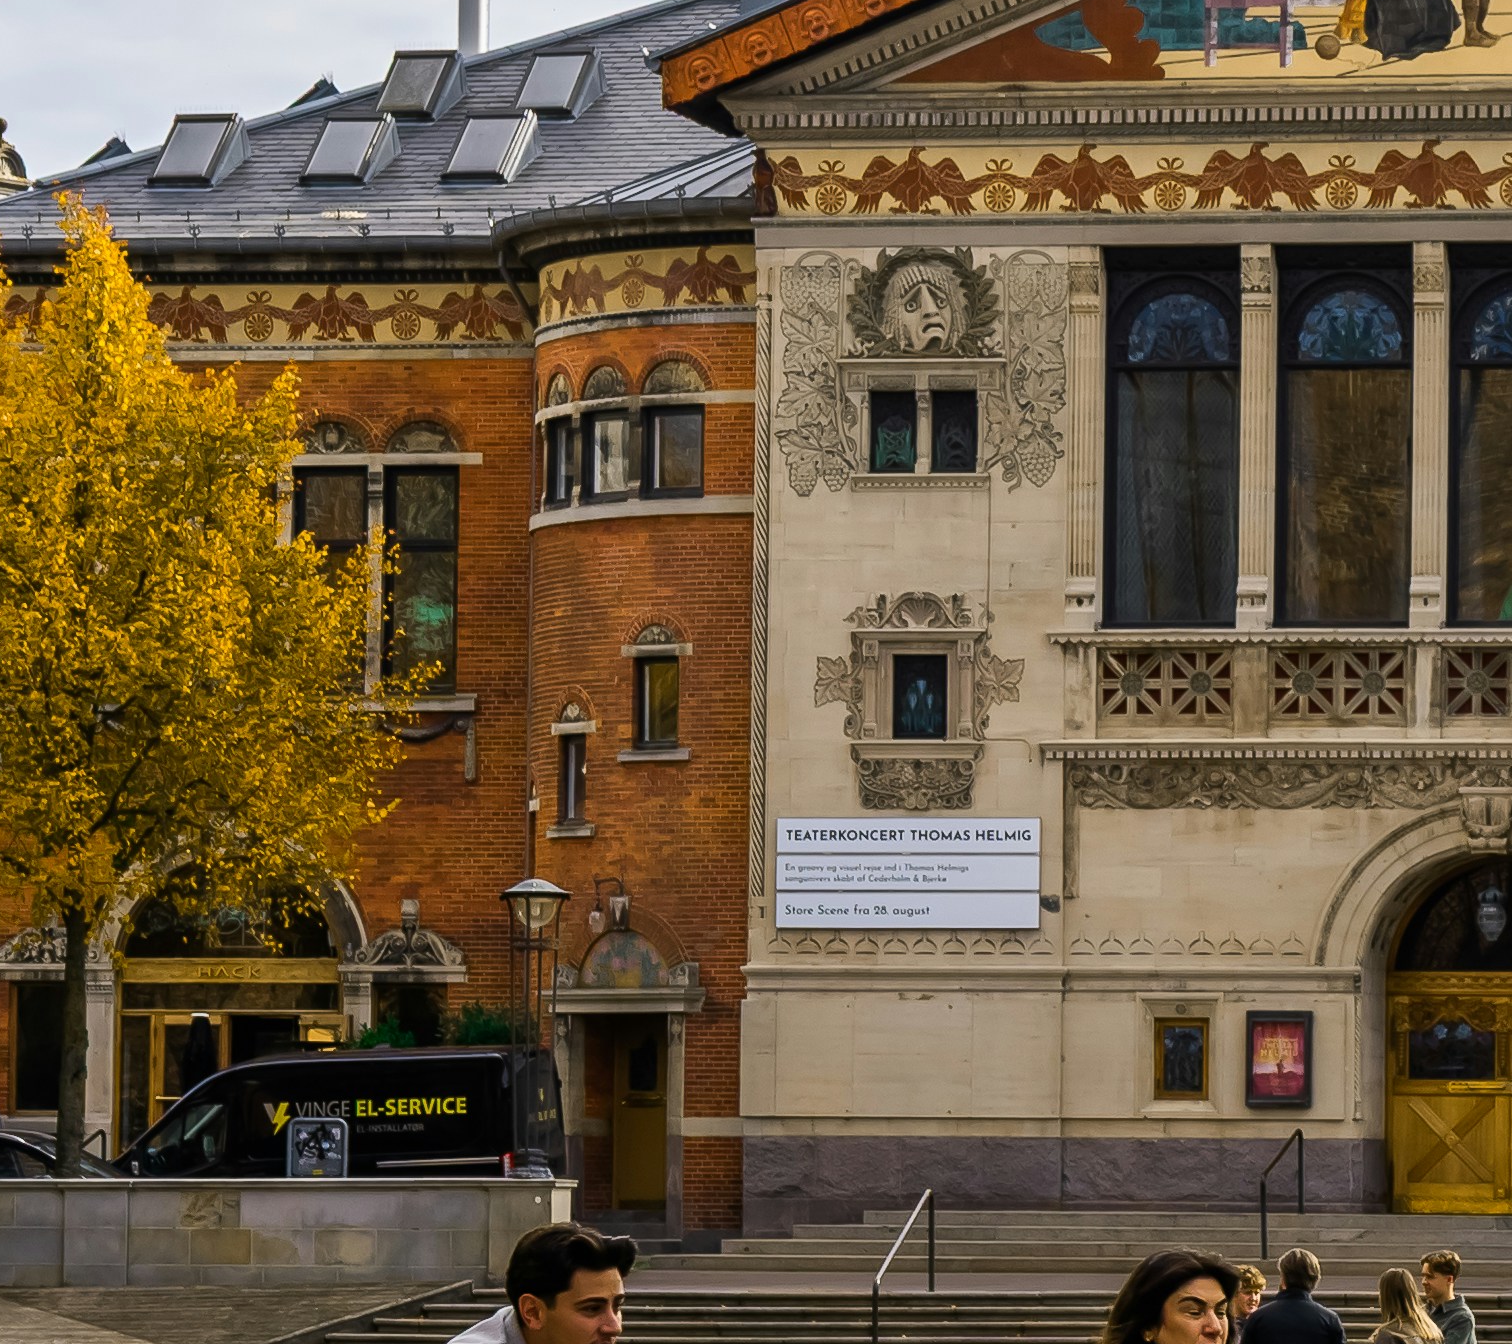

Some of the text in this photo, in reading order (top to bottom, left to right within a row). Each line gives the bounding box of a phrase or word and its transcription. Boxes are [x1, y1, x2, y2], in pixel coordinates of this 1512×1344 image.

[785, 829, 1032, 842] TEATERKONCERT THOMAS HELMIG
[785, 863, 796, 872] En
[826, 865, 837, 873] og
[904, 863, 935, 872] Thomas
[937, 863, 969, 873] Helmigs
[856, 874, 866, 883] af
[868, 874, 911, 883] Cederholm
[913, 874, 920, 883] &
[784, 904, 930, 918] Store Scene fra 28. august
[197, 964, 261, 979] HACK
[295, 1097, 468, 1118] VINGE EL-SERVICE
[356, 1122, 425, 1134] EL-INSTALLATØR
